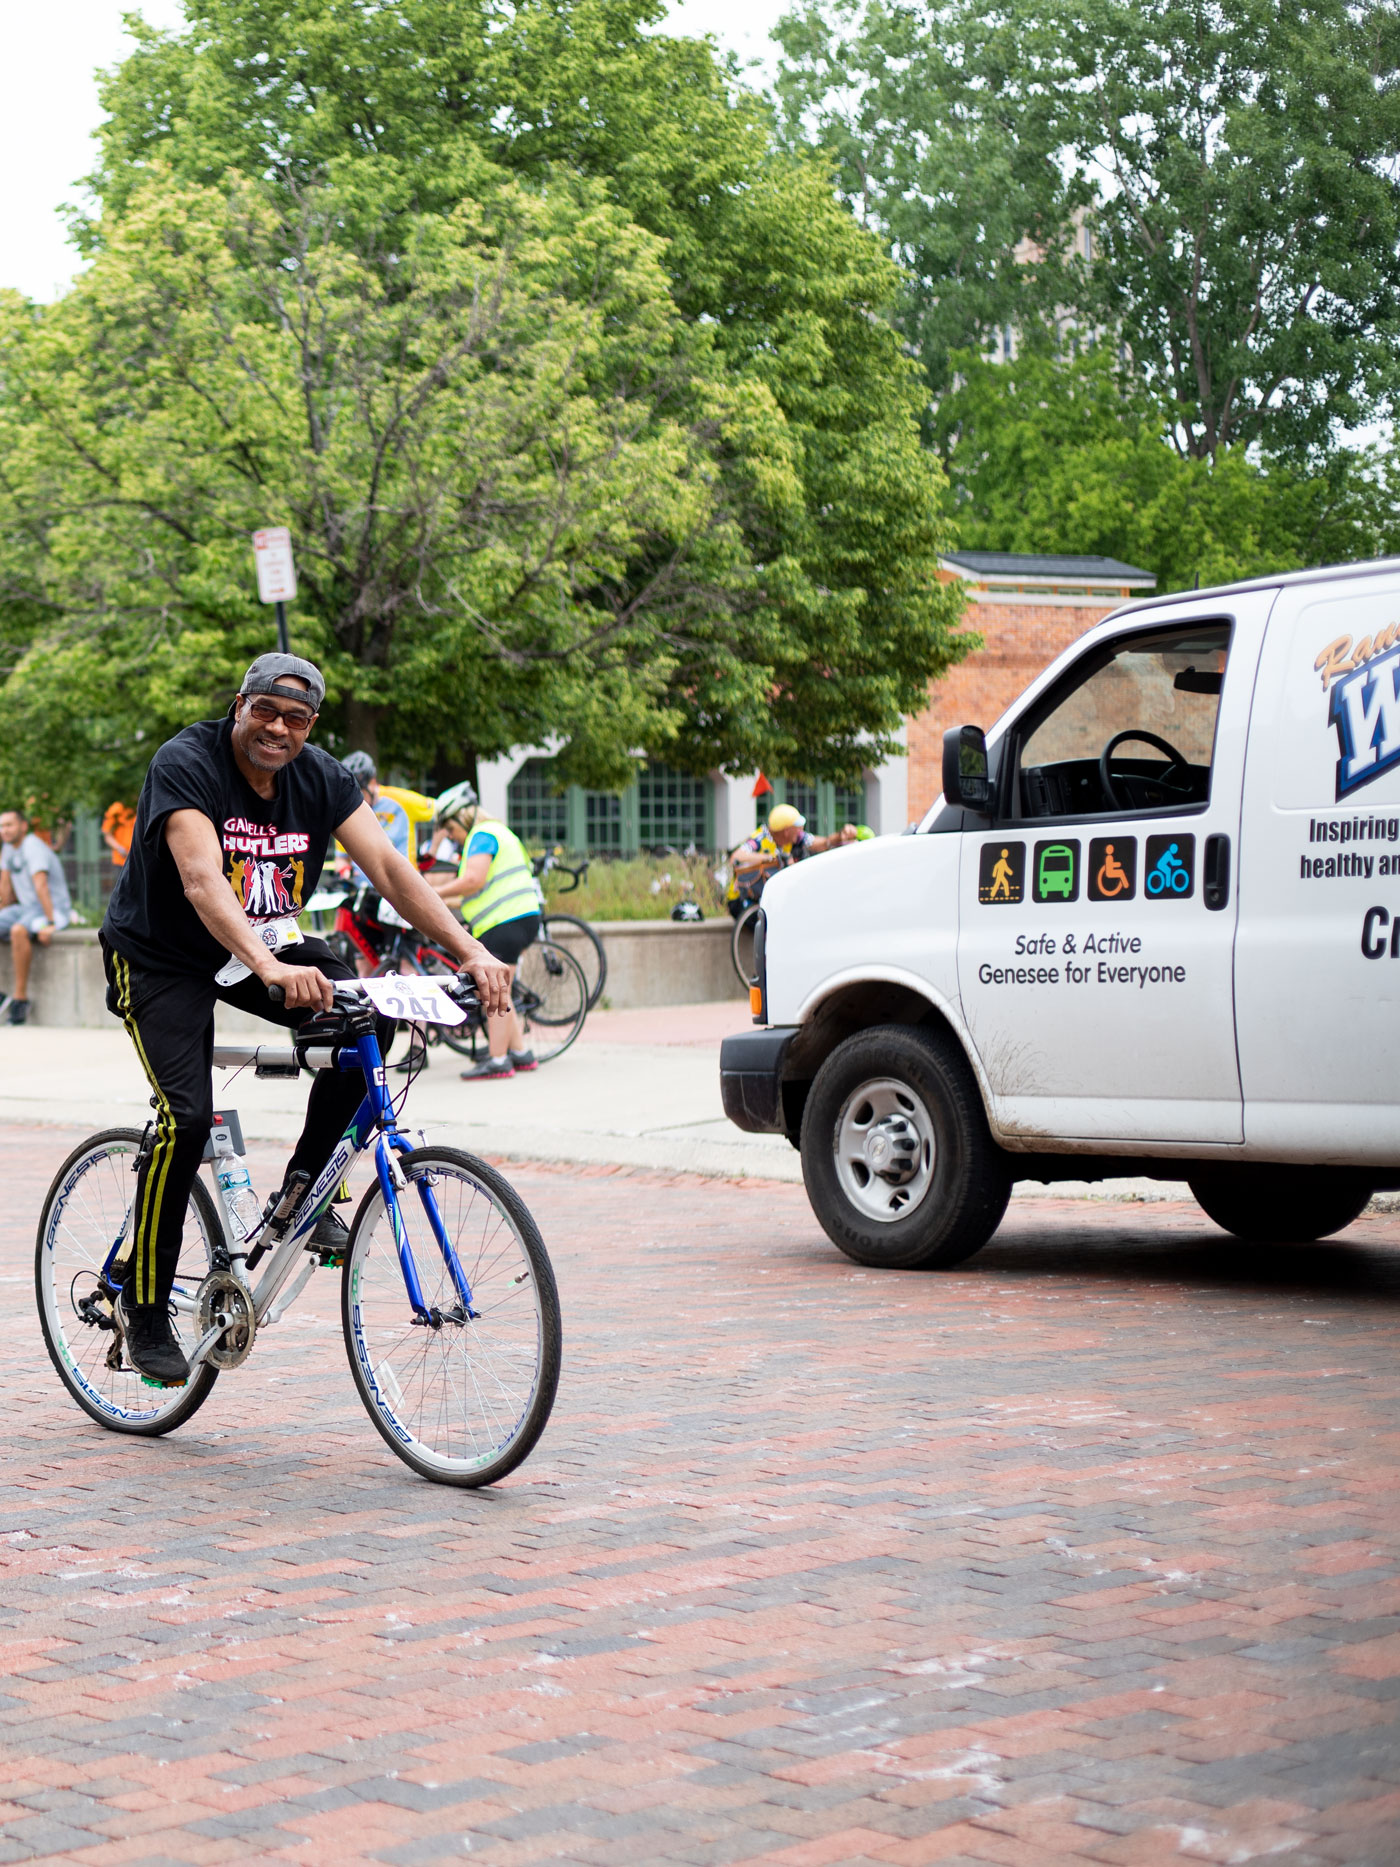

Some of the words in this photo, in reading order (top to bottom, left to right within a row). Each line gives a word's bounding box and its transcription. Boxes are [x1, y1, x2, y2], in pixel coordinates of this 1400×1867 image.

[1309, 815, 1400, 843] Inspiring
[1300, 852, 1374, 879] healthy
[1014, 933, 1057, 956] Safe
[1063, 933, 1078, 954] &
[1082, 931, 1142, 953] Active
[978, 963, 1060, 986] Genesee
[1065, 962, 1091, 983] for
[1097, 960, 1186, 988] Everyone
[386, 996, 442, 1019] 247
[46, 1149, 108, 1249] GENESIS
[294, 1146, 349, 1229] GENESIS
[353, 1304, 413, 1444] GENESIS
[71, 1367, 160, 1420] GENESIS
